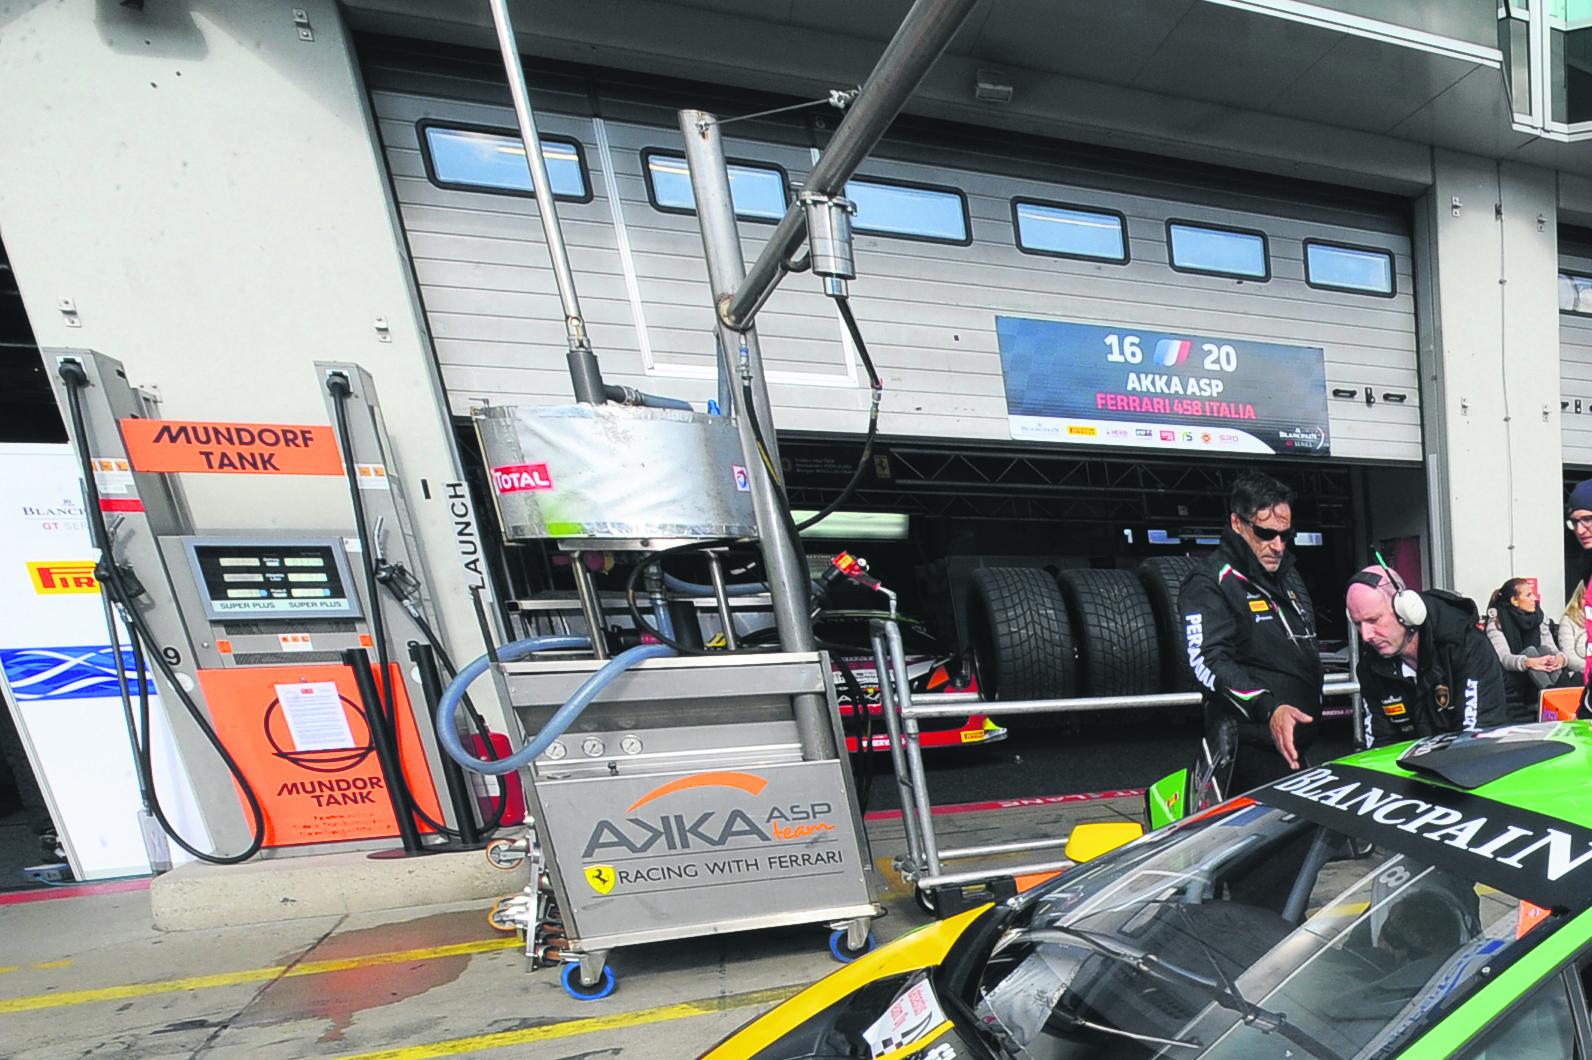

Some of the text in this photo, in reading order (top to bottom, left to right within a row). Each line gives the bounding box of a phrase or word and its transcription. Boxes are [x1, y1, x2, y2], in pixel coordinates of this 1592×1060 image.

[1103, 333, 1238, 373] 16 20
[1127, 372, 1224, 398] AKKA ASP
[1096, 392, 1257, 420] FERRARI 458 ITALIA
[152, 424, 315, 450] MUNDORF
[199, 449, 281, 472] TANK
[494, 469, 550, 490] TOTAL
[22, 506, 87, 517] BLANC
[42, 521, 88, 531] GT SER
[446, 482, 486, 592] LAUNCH
[37, 566, 97, 589] PIR
[220, 602, 250, 610] SUPER
[162, 646, 182, 666] 9
[276, 776, 384, 797] MUNDOR
[310, 790, 376, 808] TANK
[765, 802, 833, 825] ASP
[772, 820, 836, 841] team
[619, 850, 844, 885] RACING WITH FERRARI
